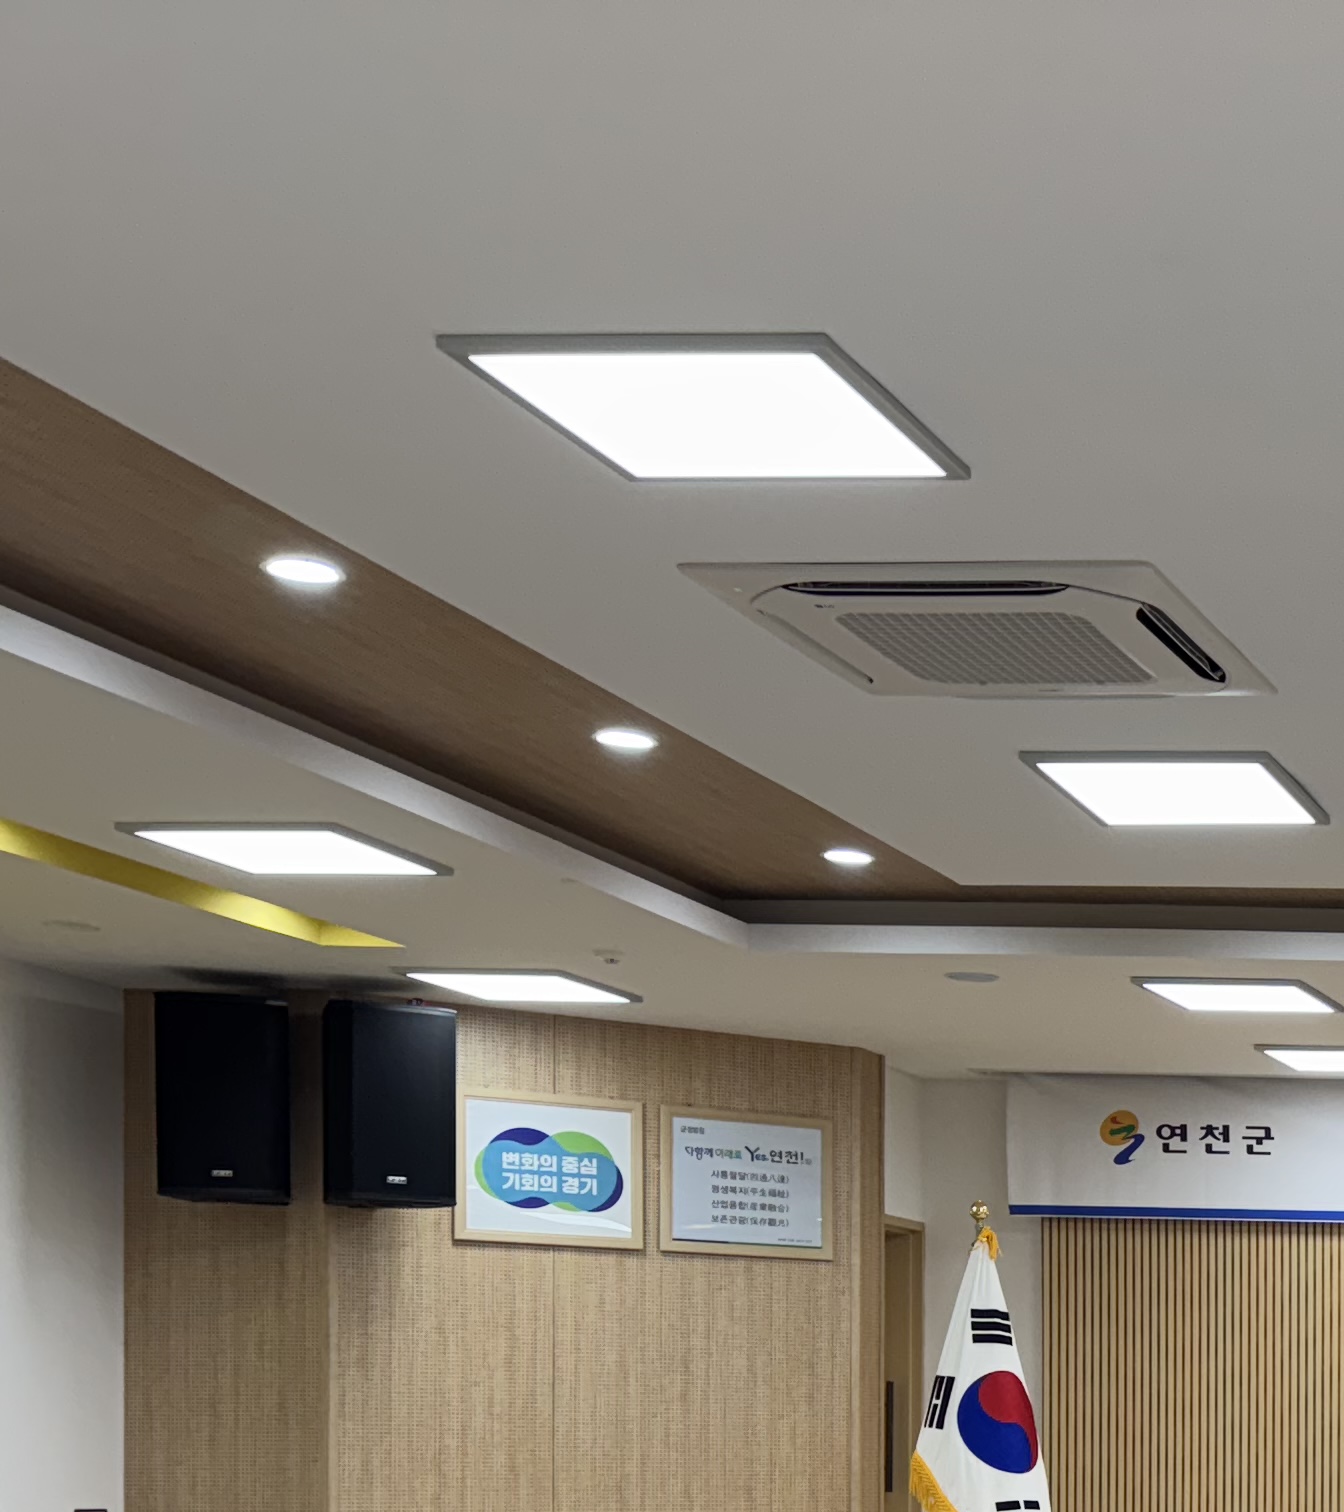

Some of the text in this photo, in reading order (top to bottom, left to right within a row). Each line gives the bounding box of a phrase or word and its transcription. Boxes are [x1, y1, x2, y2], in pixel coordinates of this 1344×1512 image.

[1155, 1123, 1275, 1156] 연천군
[502, 1151, 598, 1175] 변화의 중심
[502, 1172, 598, 1196] 기회의 경기
